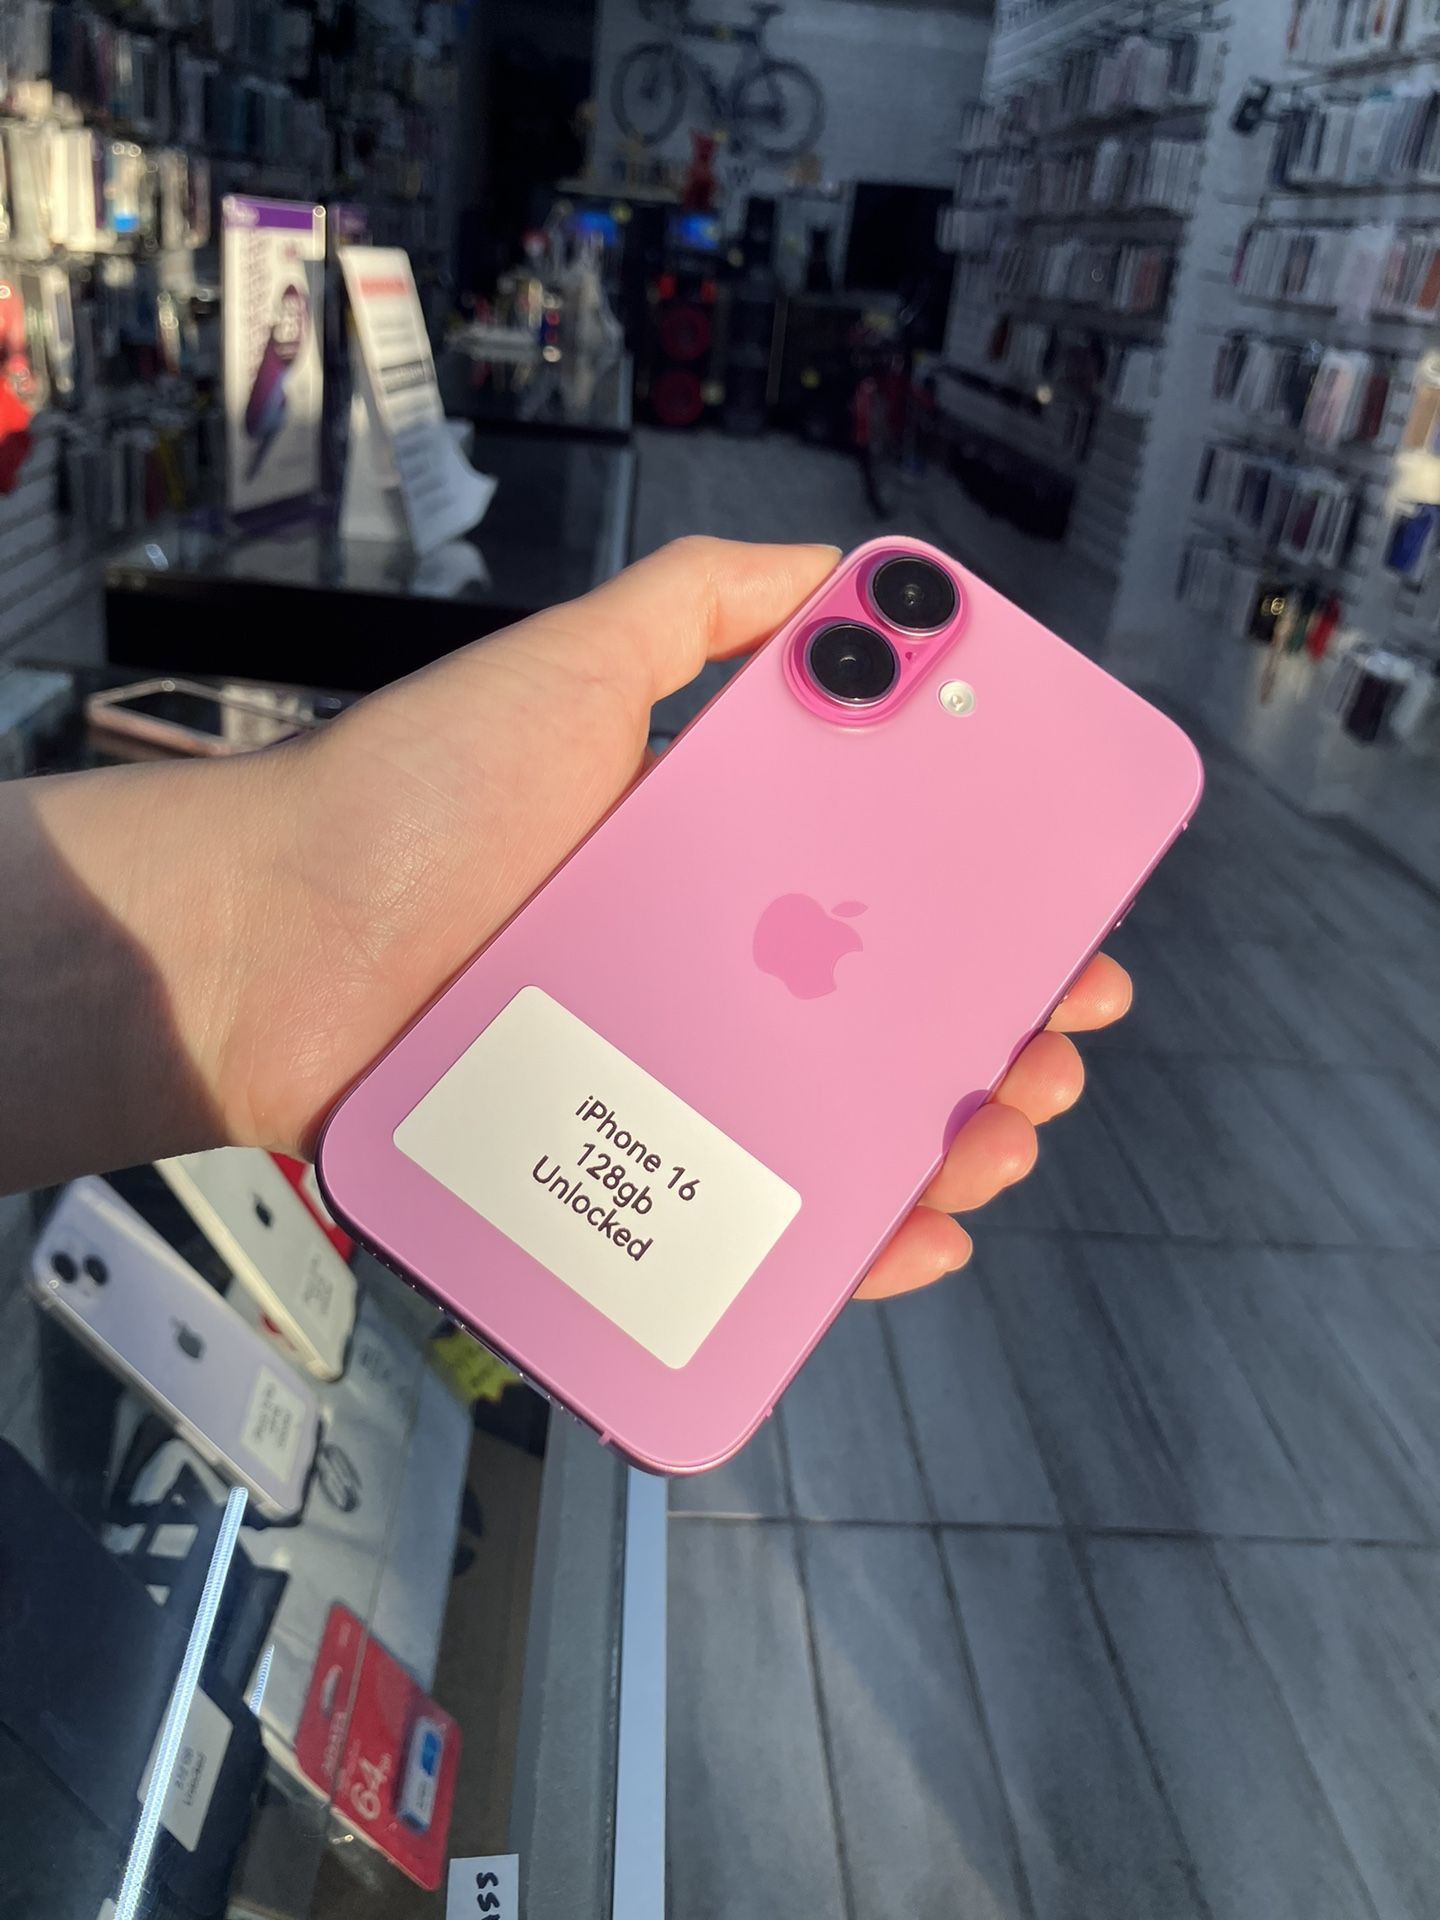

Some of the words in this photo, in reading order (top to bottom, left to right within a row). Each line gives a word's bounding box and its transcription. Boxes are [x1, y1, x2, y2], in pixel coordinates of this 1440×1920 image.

[575, 1096, 662, 1173] iPhone
[667, 1166, 701, 1201] 16
[577, 1143, 653, 1215] 128gb
[532, 1155, 653, 1261] Unlocked
